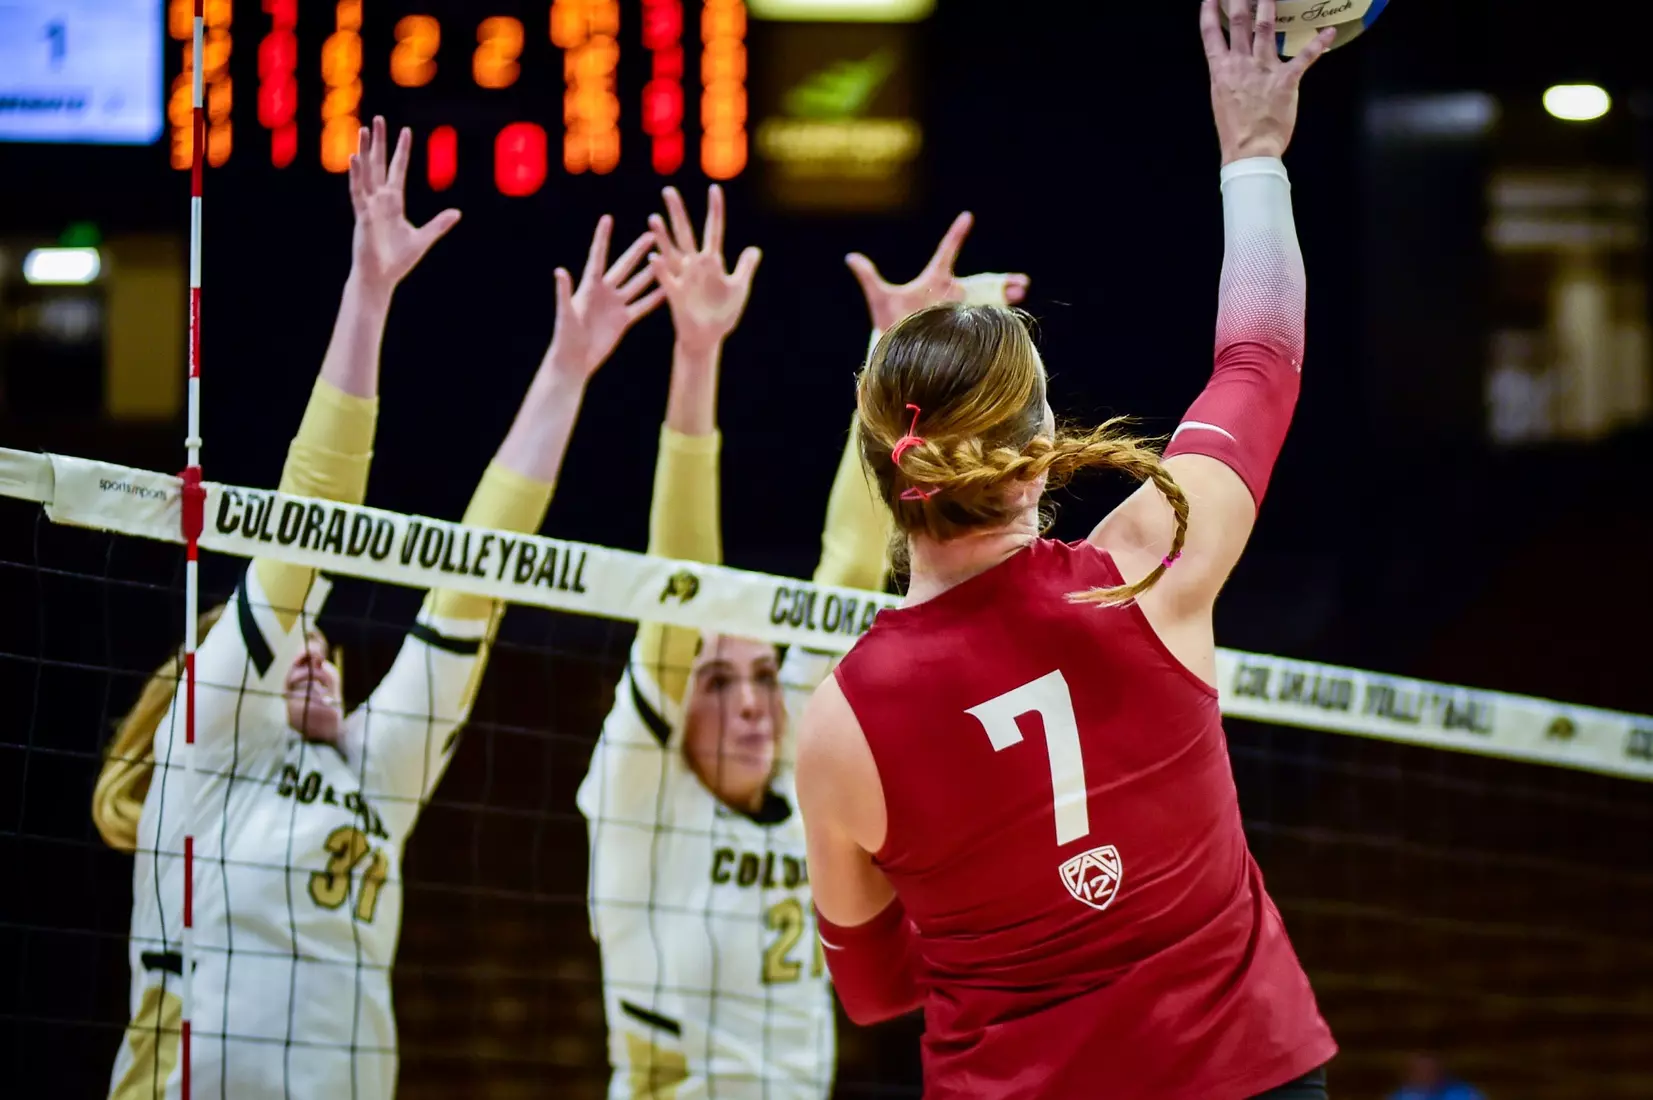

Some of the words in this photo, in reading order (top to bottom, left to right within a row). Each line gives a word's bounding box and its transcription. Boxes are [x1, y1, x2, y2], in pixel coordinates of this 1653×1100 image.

[1301, 0, 1352, 21] Touch
[215, 489, 395, 562] COLORADO
[400, 520, 589, 593] VOLLEYBALL
[770, 585, 897, 636] COLORA
[963, 668, 1090, 847] 7
[308, 825, 389, 923] 31
[711, 847, 809, 890] COLO
[1062, 847, 1119, 896] PAC
[1082, 874, 1113, 901] 12
